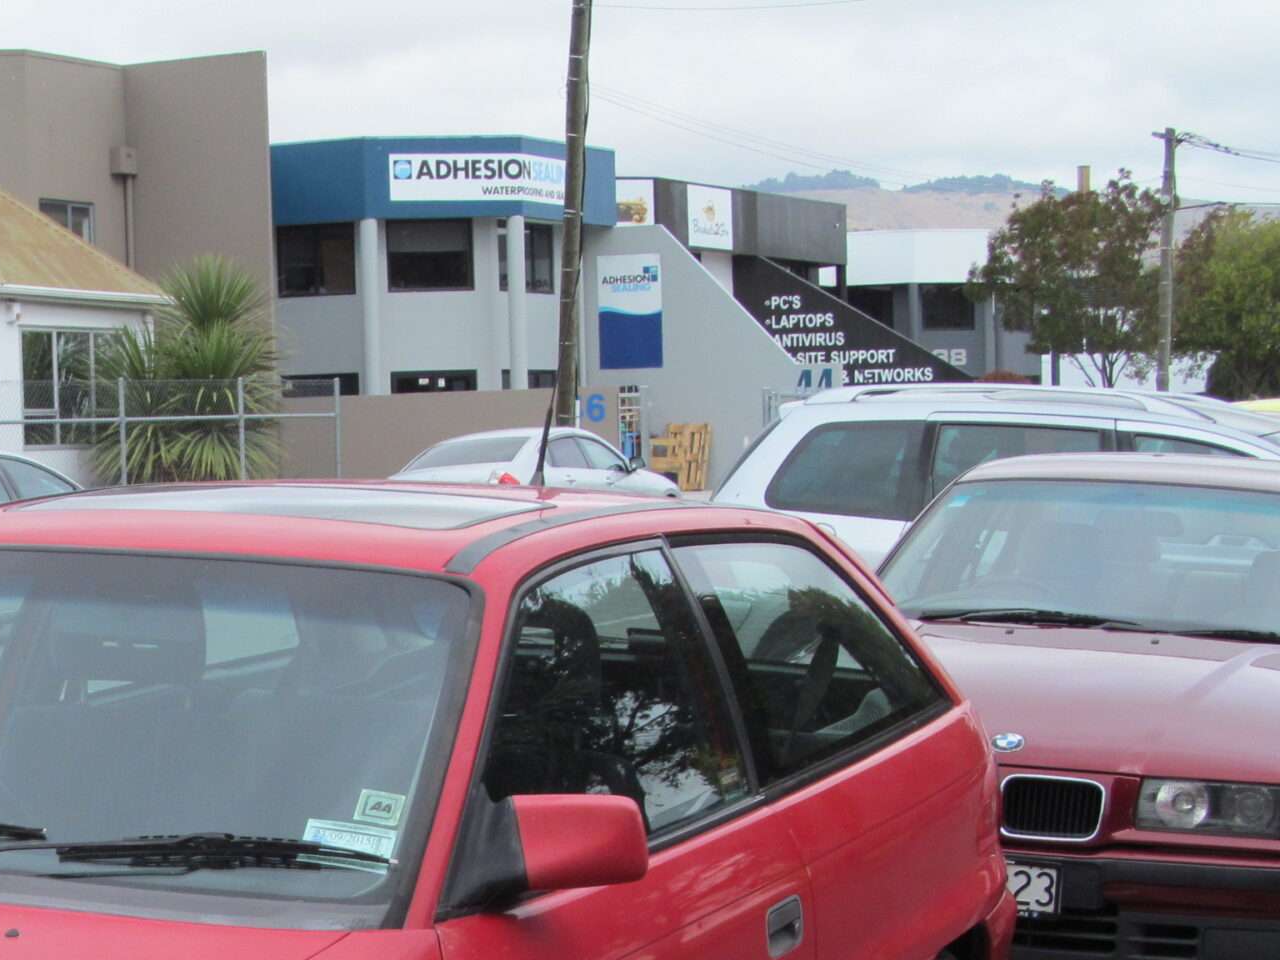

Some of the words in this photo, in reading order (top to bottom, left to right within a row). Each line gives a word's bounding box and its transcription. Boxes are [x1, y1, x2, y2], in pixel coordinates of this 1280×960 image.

[416, 159, 532, 180] ADHESION
[602, 274, 650, 285] ADHESION
[771, 296, 801, 310] PC'S
[771, 313, 834, 329] LAPTOPS
[773, 332, 845, 347] ANTIVIRUS
[830, 350, 896, 365] SUPPORT
[854, 368, 933, 383] NETWORKS
[369, 801, 393, 814] AA
